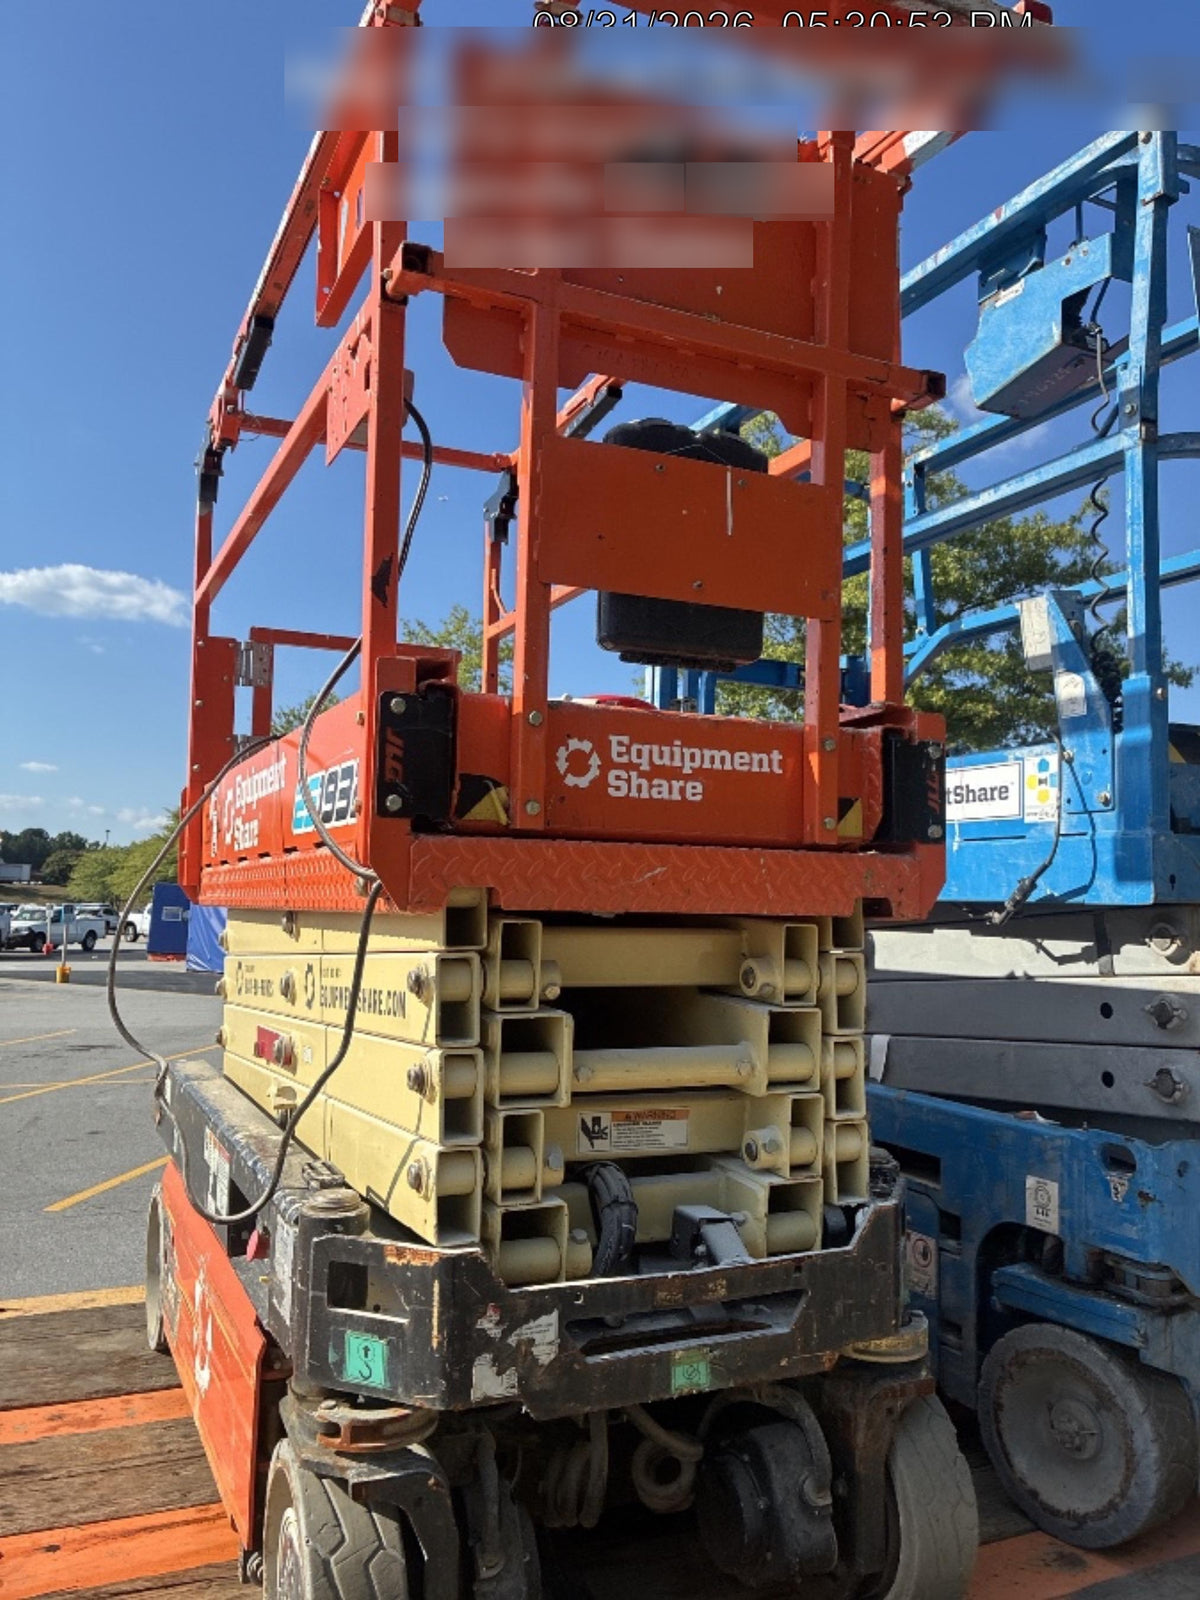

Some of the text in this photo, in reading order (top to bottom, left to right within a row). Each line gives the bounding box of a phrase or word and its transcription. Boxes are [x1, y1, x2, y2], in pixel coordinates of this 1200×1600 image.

[608, 735, 783, 774] Equipment
[236, 751, 287, 814] Equipment
[608, 769, 703, 801] Share
[234, 815, 259, 852] Share
